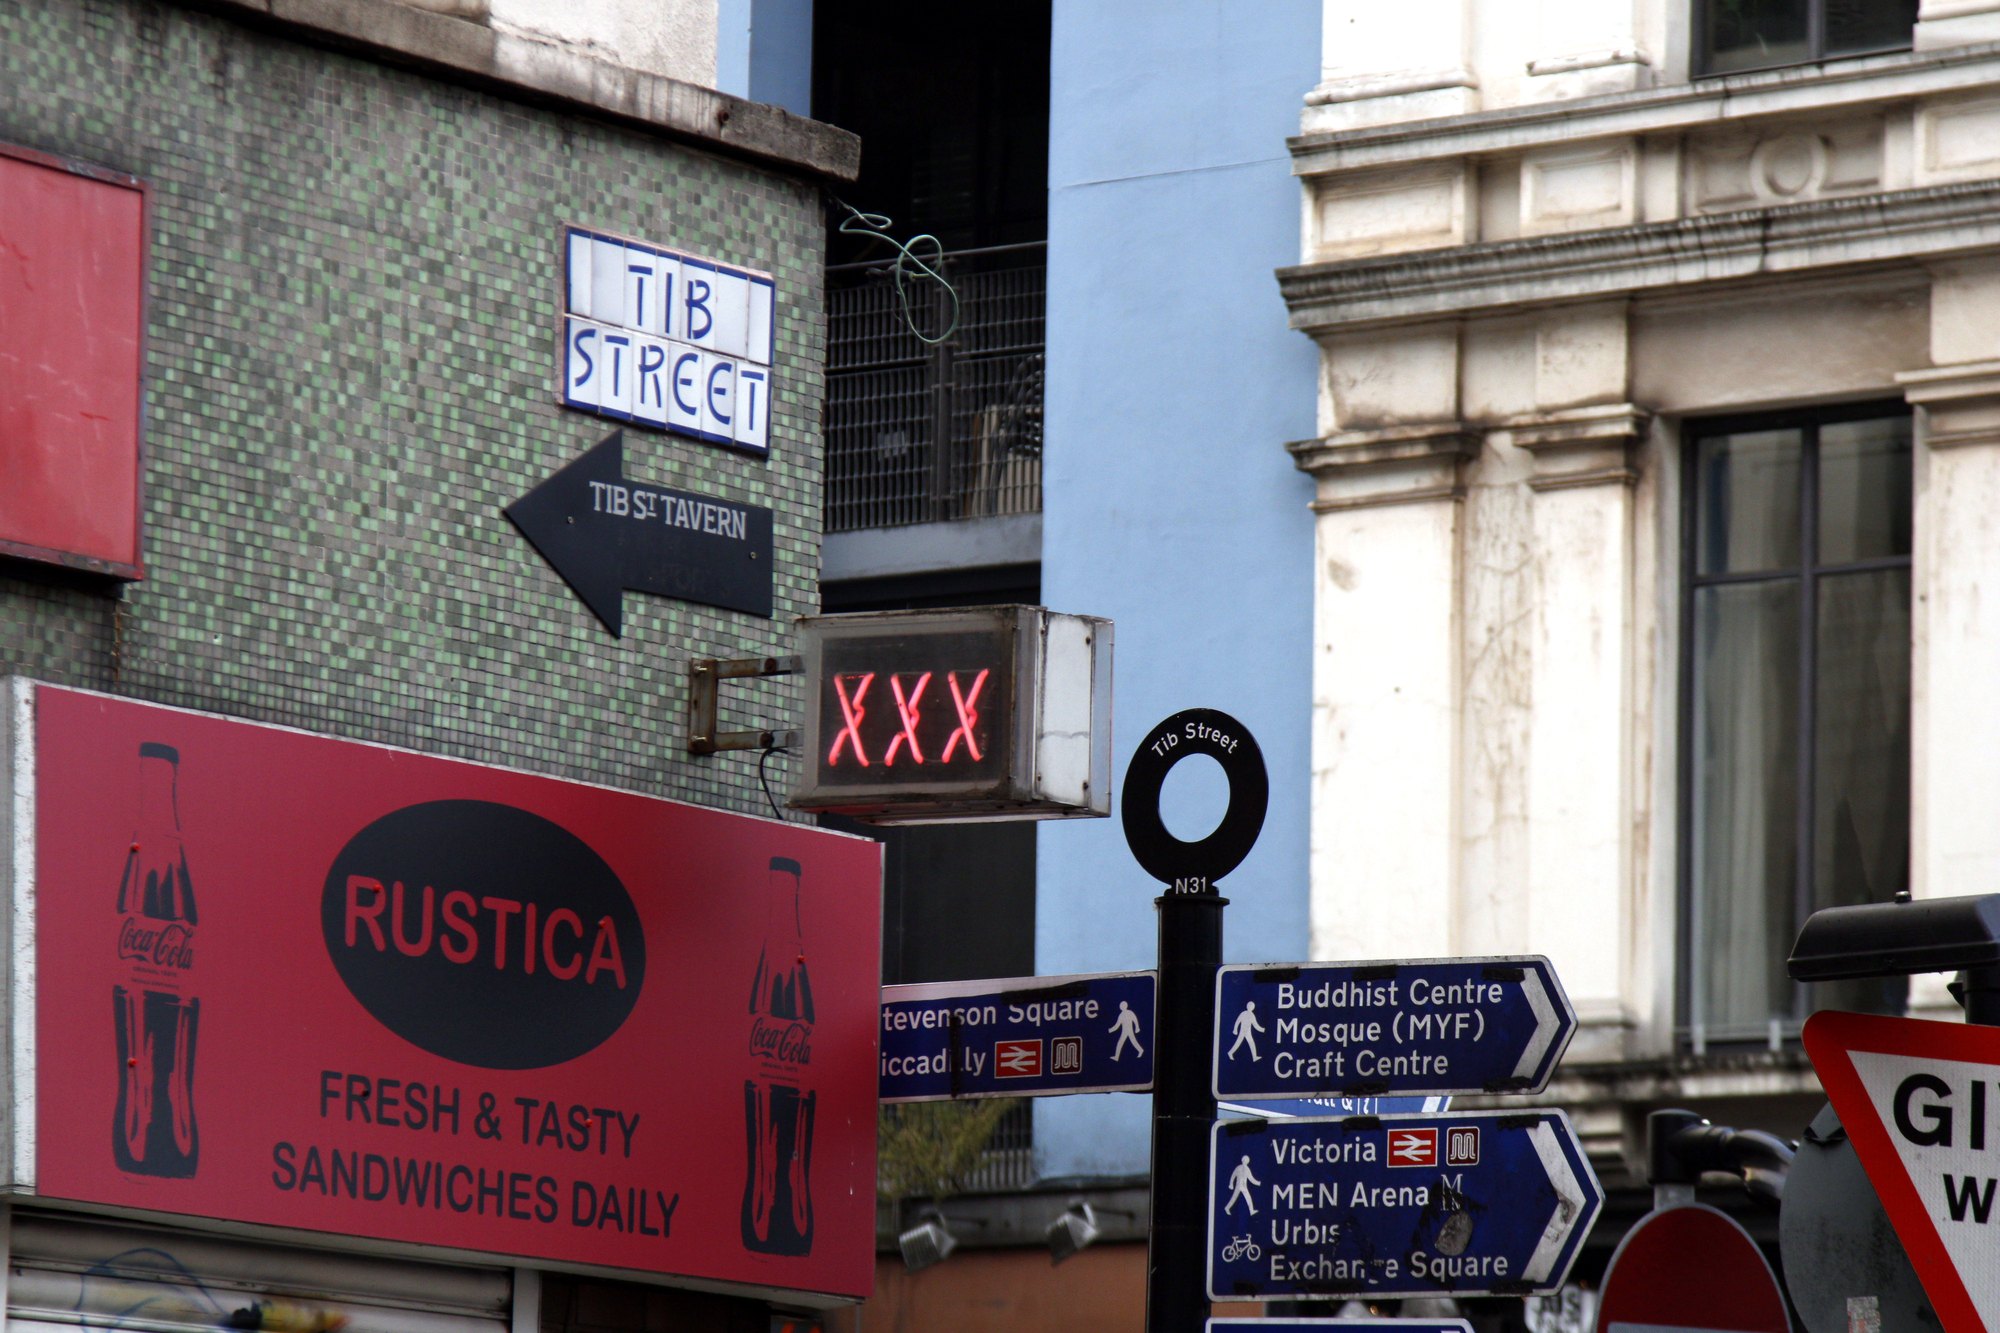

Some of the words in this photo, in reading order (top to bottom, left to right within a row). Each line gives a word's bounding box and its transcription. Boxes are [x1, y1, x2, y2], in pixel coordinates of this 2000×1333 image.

[628, 265, 712, 339] TIB
[574, 329, 764, 431] STREET
[589, 481, 630, 517] TIB
[660, 495, 746, 540] TAVERN
[1151, 732, 1179, 757] Tib
[1185, 722, 1239, 754] Street
[1175, 876, 1207, 894] N31
[344, 874, 627, 989] RUSTICA
[1278, 981, 1398, 1009] Buddhist
[1409, 978, 1503, 1005] Centre
[883, 1006, 997, 1031] tevenson
[1008, 1000, 1100, 1027] Square
[1276, 1018, 1381, 1047] Mosque
[1392, 1008, 1485, 1043] (MYF)
[1274, 1051, 1344, 1079] Craft
[1356, 1050, 1448, 1076] Centre
[320, 1070, 460, 1135] FRESH
[474, 1092, 502, 1141] &
[514, 1097, 640, 1158] TASTY
[1893, 1073, 2000, 1150] GI
[1272, 1136, 1376, 1165] Victoria
[272, 1141, 558, 1223] SANDWICHES
[572, 1181, 679, 1238] DAILY
[1272, 1183, 1338, 1210] MEN
[1350, 1181, 1429, 1208] Arena
[1271, 1218, 1340, 1245] Urbis
[1410, 1252, 1508, 1282] Square
